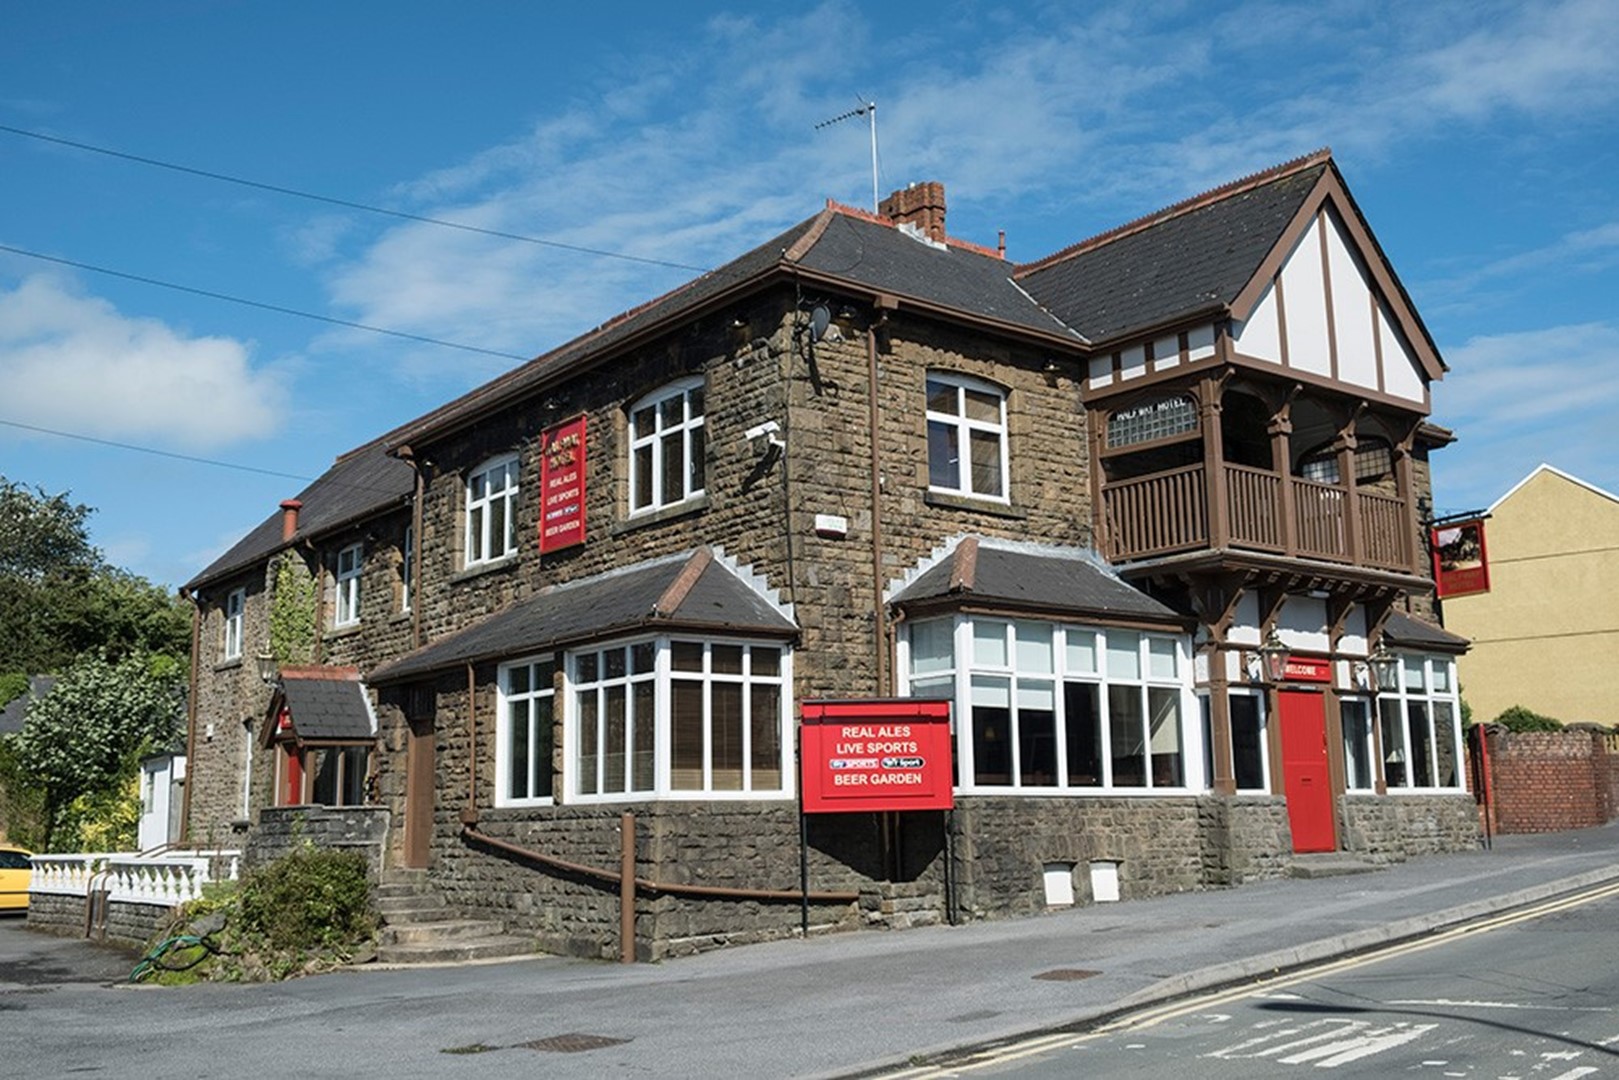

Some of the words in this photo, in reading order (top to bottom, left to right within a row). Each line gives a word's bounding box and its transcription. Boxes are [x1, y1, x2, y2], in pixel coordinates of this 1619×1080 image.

[1157, 398, 1187, 412] HOTEL
[1285, 664, 1317, 676] WELCOME
[842, 726, 875, 738] REAL
[878, 726, 911, 738] ALES
[836, 743, 864, 754] LIVE
[866, 742, 918, 754] SPORTS
[834, 774, 868, 785] BEER
[870, 773, 922, 784] GARDEN
